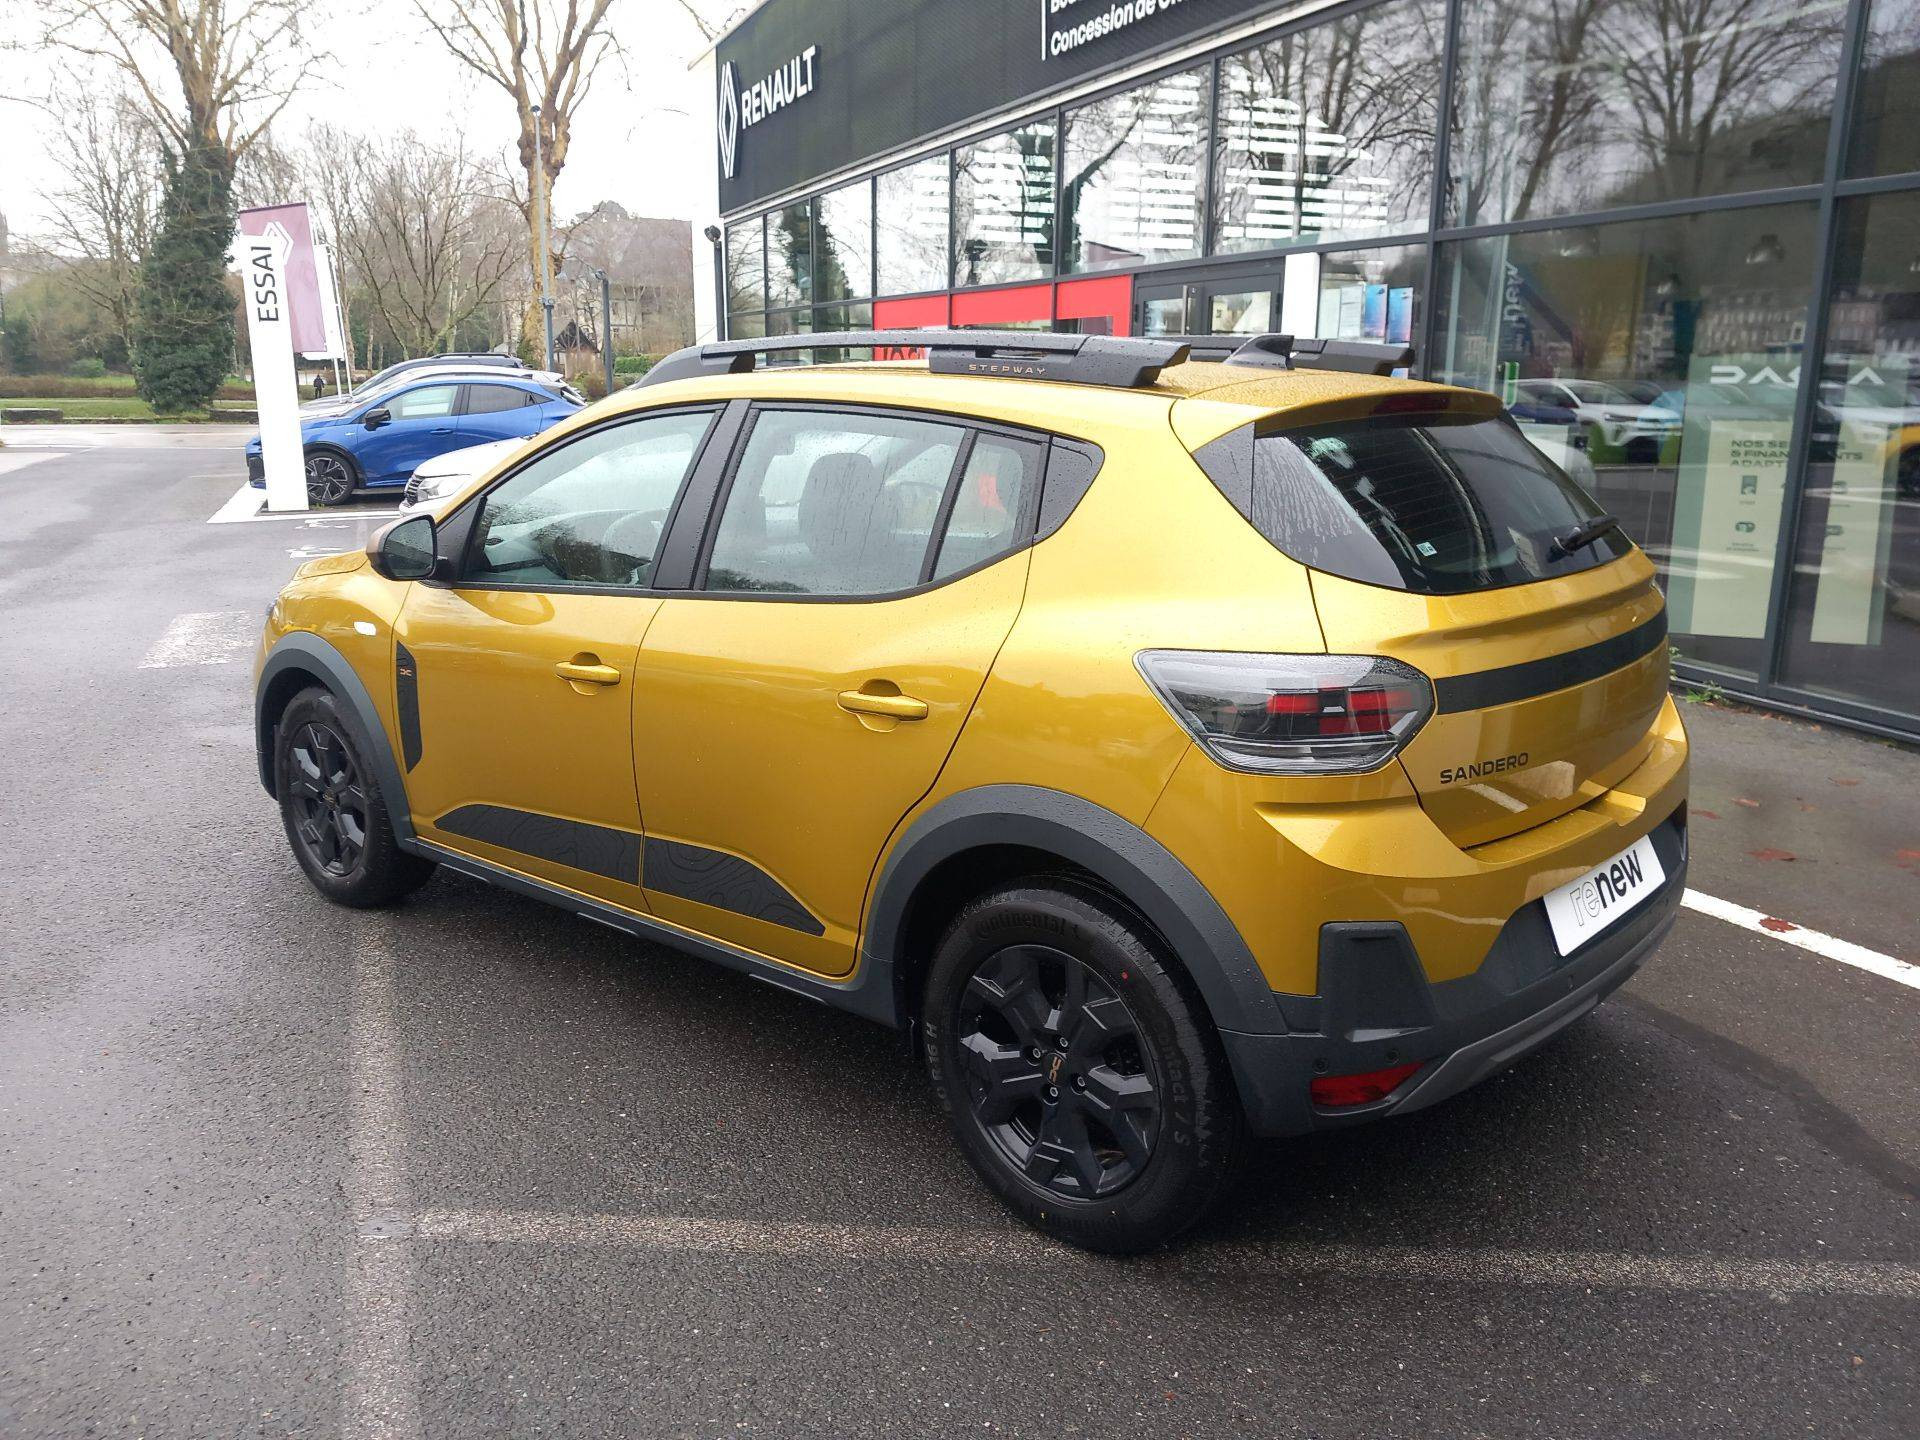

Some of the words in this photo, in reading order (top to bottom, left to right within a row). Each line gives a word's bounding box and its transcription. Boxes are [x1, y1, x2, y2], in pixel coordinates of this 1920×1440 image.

[1050, 3, 1134, 56] Concession
[741, 44, 816, 130] RENAULT
[250, 246, 279, 323] ESSAI
[968, 364, 1046, 375] STEPWAY
[1731, 459, 1786, 468] ADAPT
[1440, 752, 1529, 784] SANDERO
[1569, 849, 1644, 927] renew
